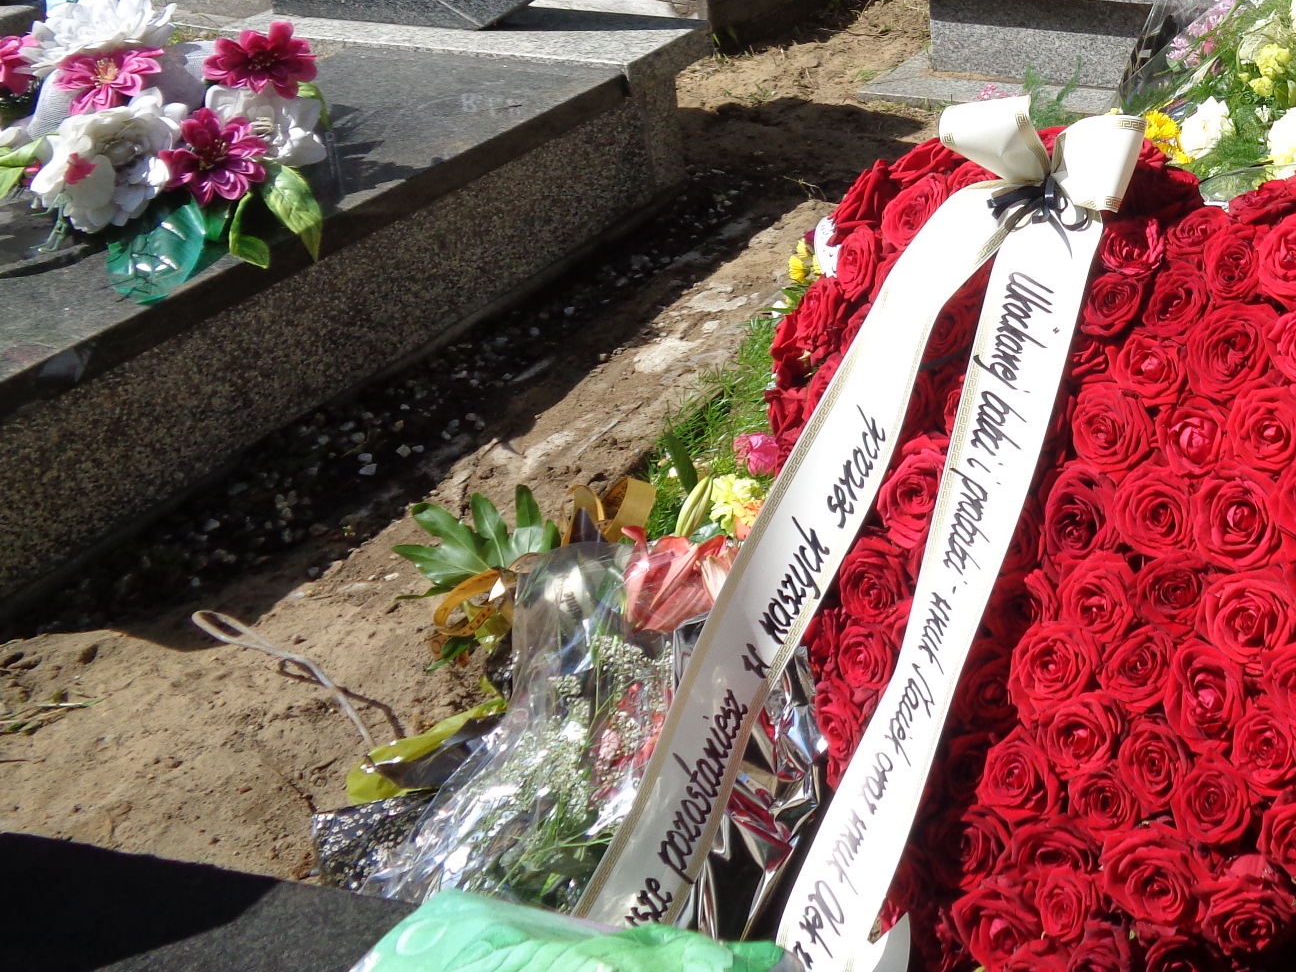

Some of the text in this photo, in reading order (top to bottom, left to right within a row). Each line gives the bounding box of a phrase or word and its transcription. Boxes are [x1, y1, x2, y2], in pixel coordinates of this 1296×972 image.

[970, 390, 1027, 466] babci
[657, 688, 747, 884] pozostaniesz
[758, 515, 831, 647] naszych
[825, 405, 888, 530] sercach
